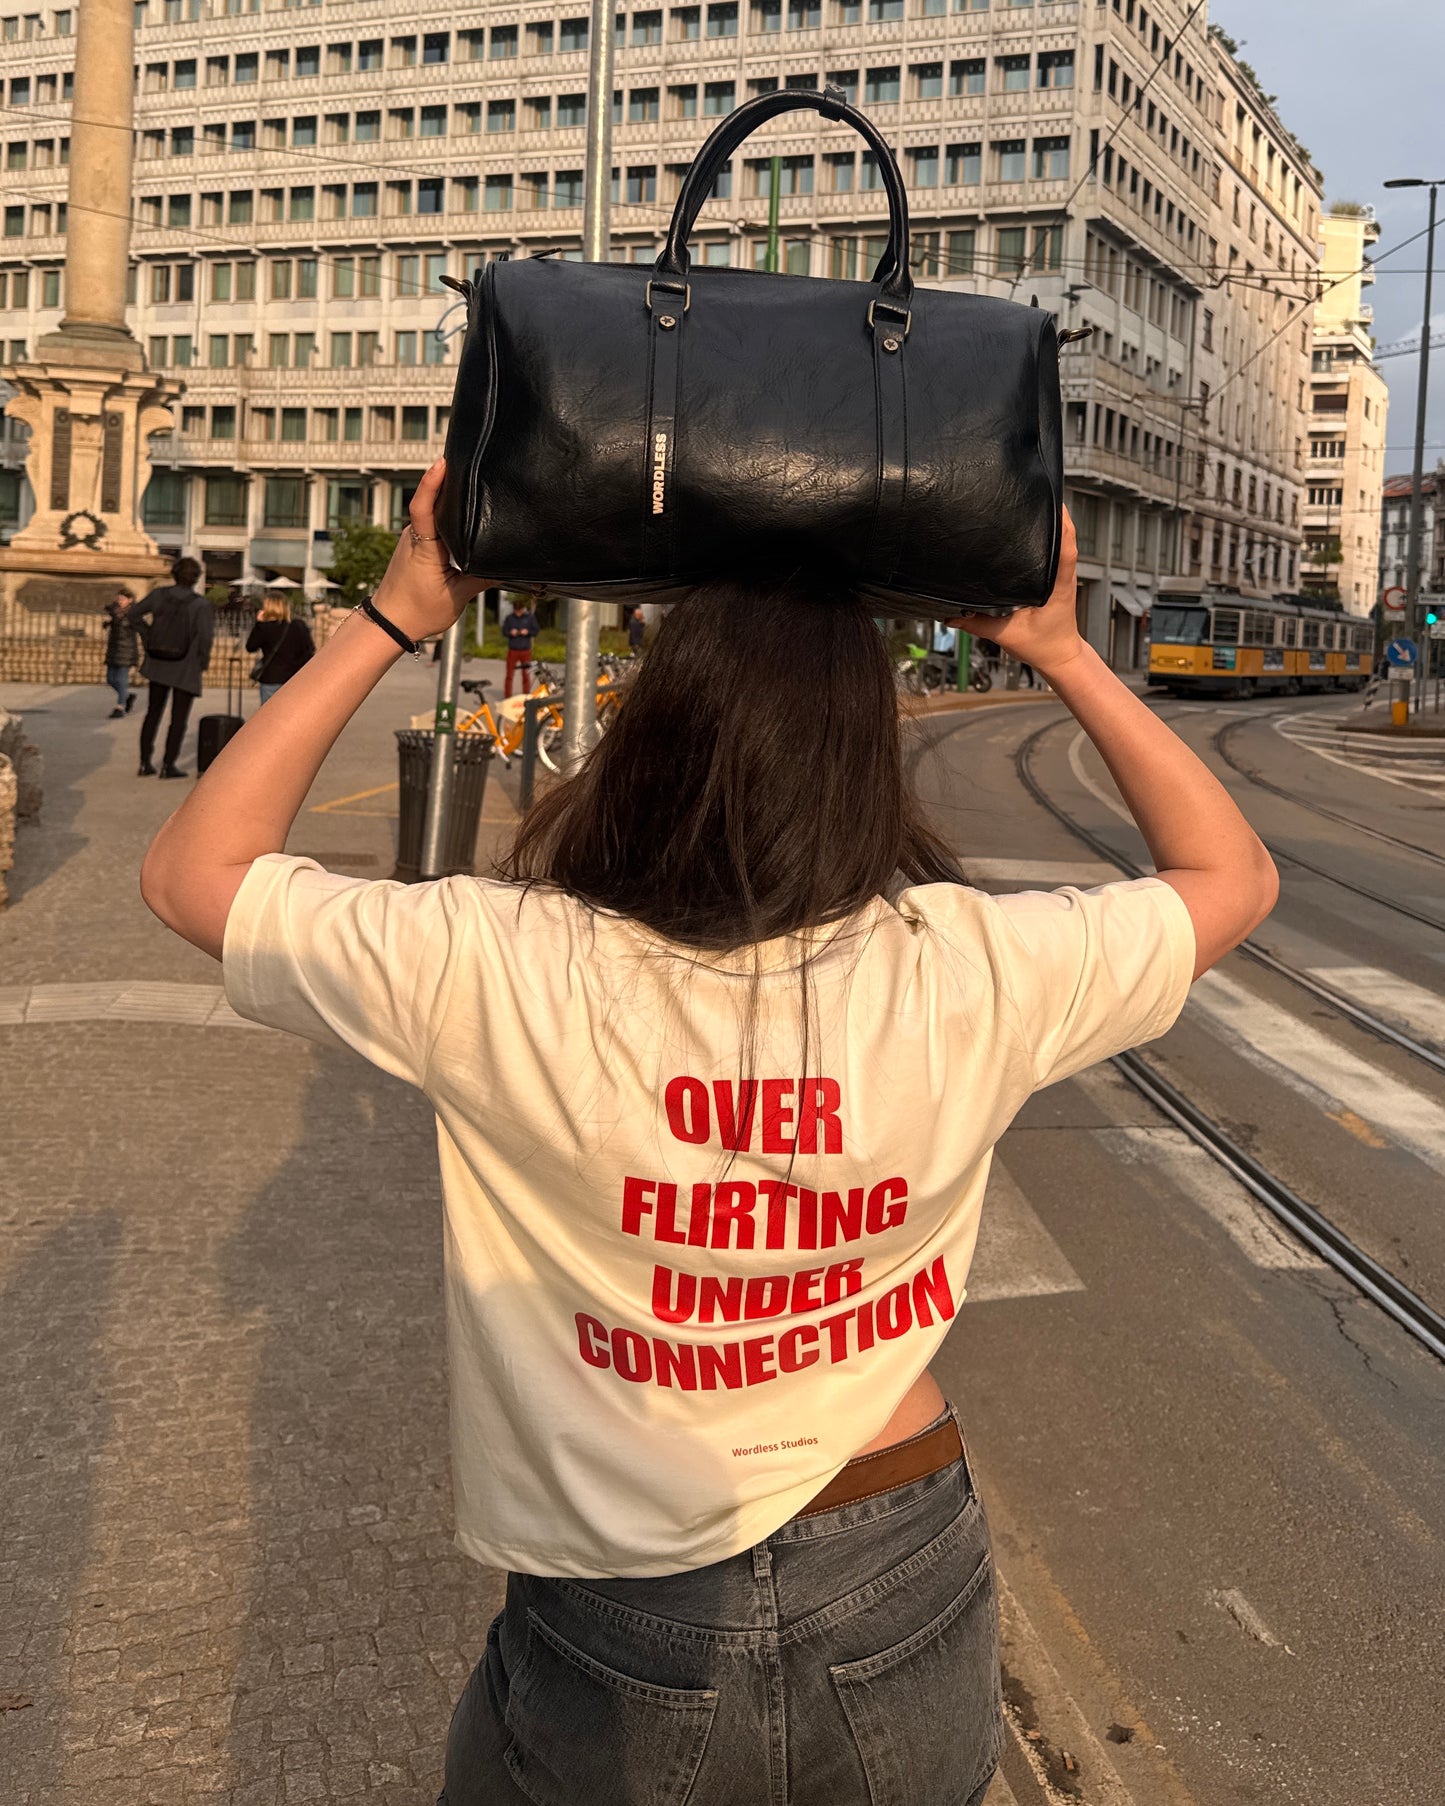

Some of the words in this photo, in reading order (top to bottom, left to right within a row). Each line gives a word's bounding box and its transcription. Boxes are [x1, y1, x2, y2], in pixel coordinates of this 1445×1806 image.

[653, 433, 667, 514] WORDLESS
[664, 1076, 843, 1155] OVER
[621, 1176, 909, 1251] FLIRTING
[574, 1254, 956, 1392] CONNECTION
[651, 1257, 865, 1324] UNDER
[732, 1444, 779, 1457] Wordless
[780, 1437, 818, 1450] Studios
